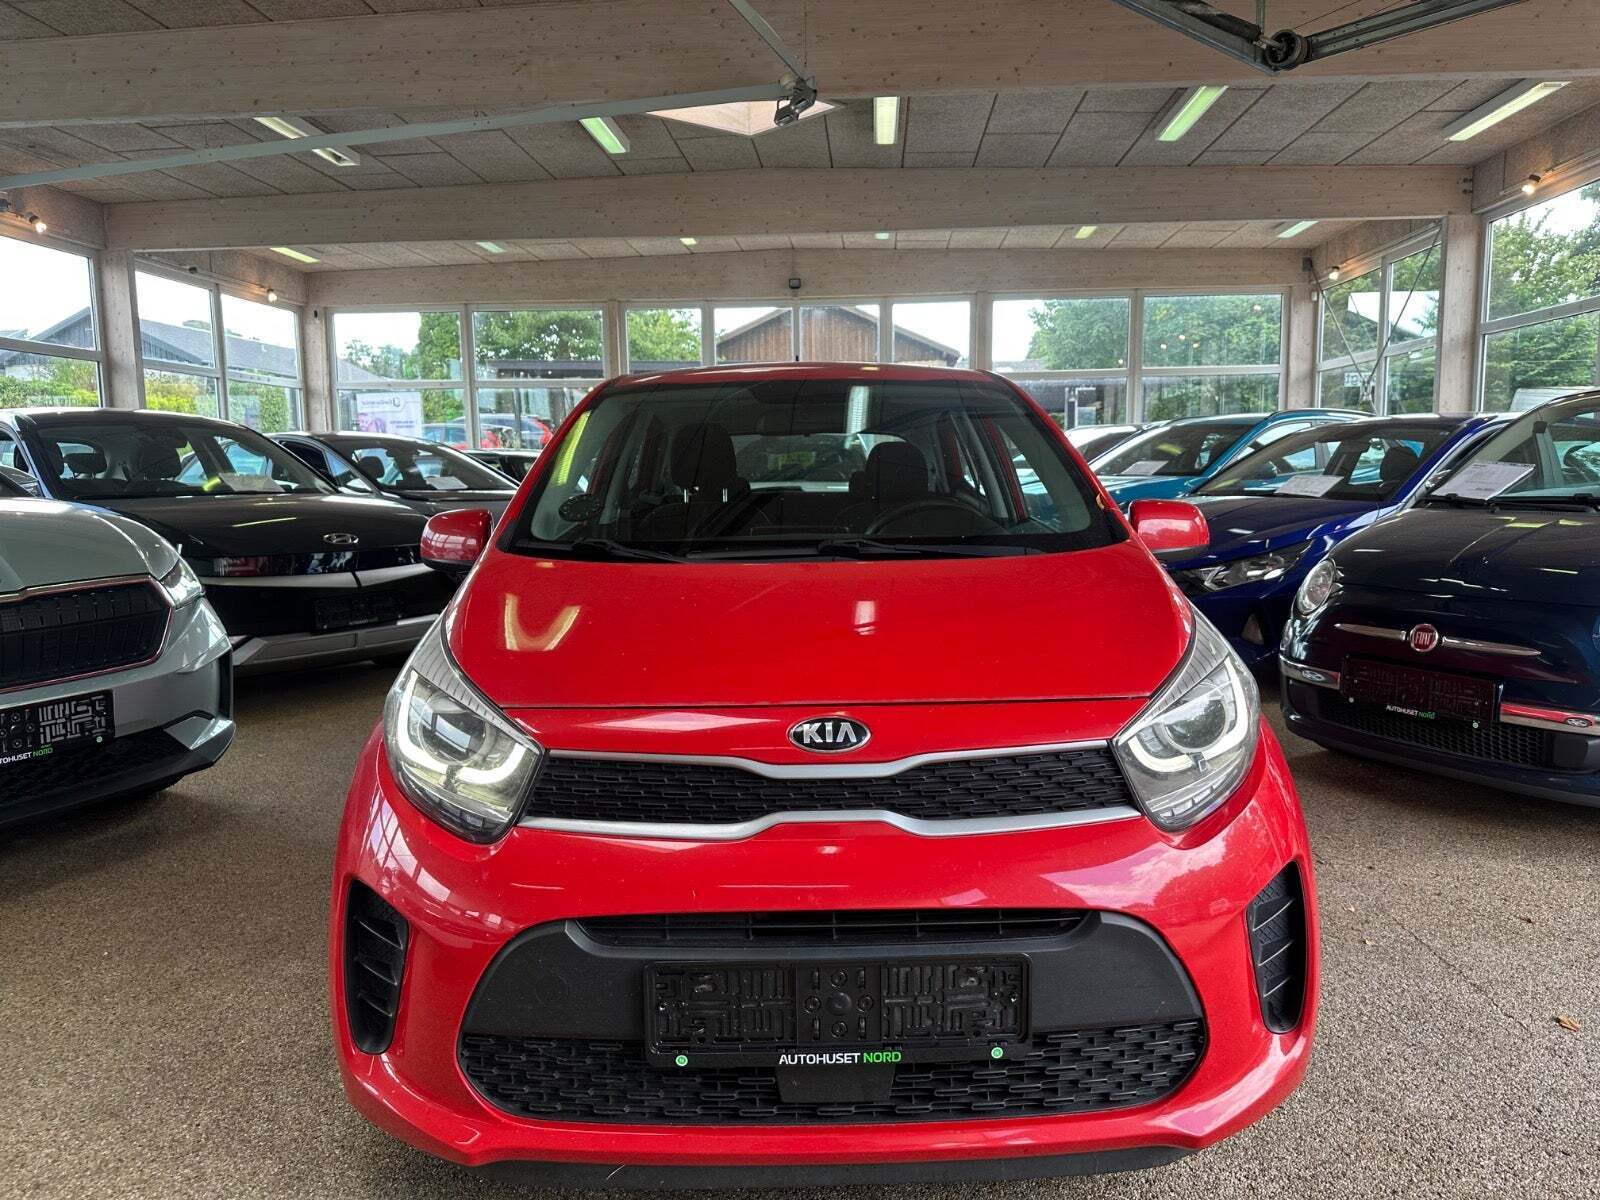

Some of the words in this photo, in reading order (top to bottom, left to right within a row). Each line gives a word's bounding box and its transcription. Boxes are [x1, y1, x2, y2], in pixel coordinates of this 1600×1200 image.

[1414, 631, 1433, 646] FIAT
[803, 722, 857, 744] KIA
[778, 1052, 861, 1065] AUTOHUSET
[863, 1051, 902, 1063] NORD
